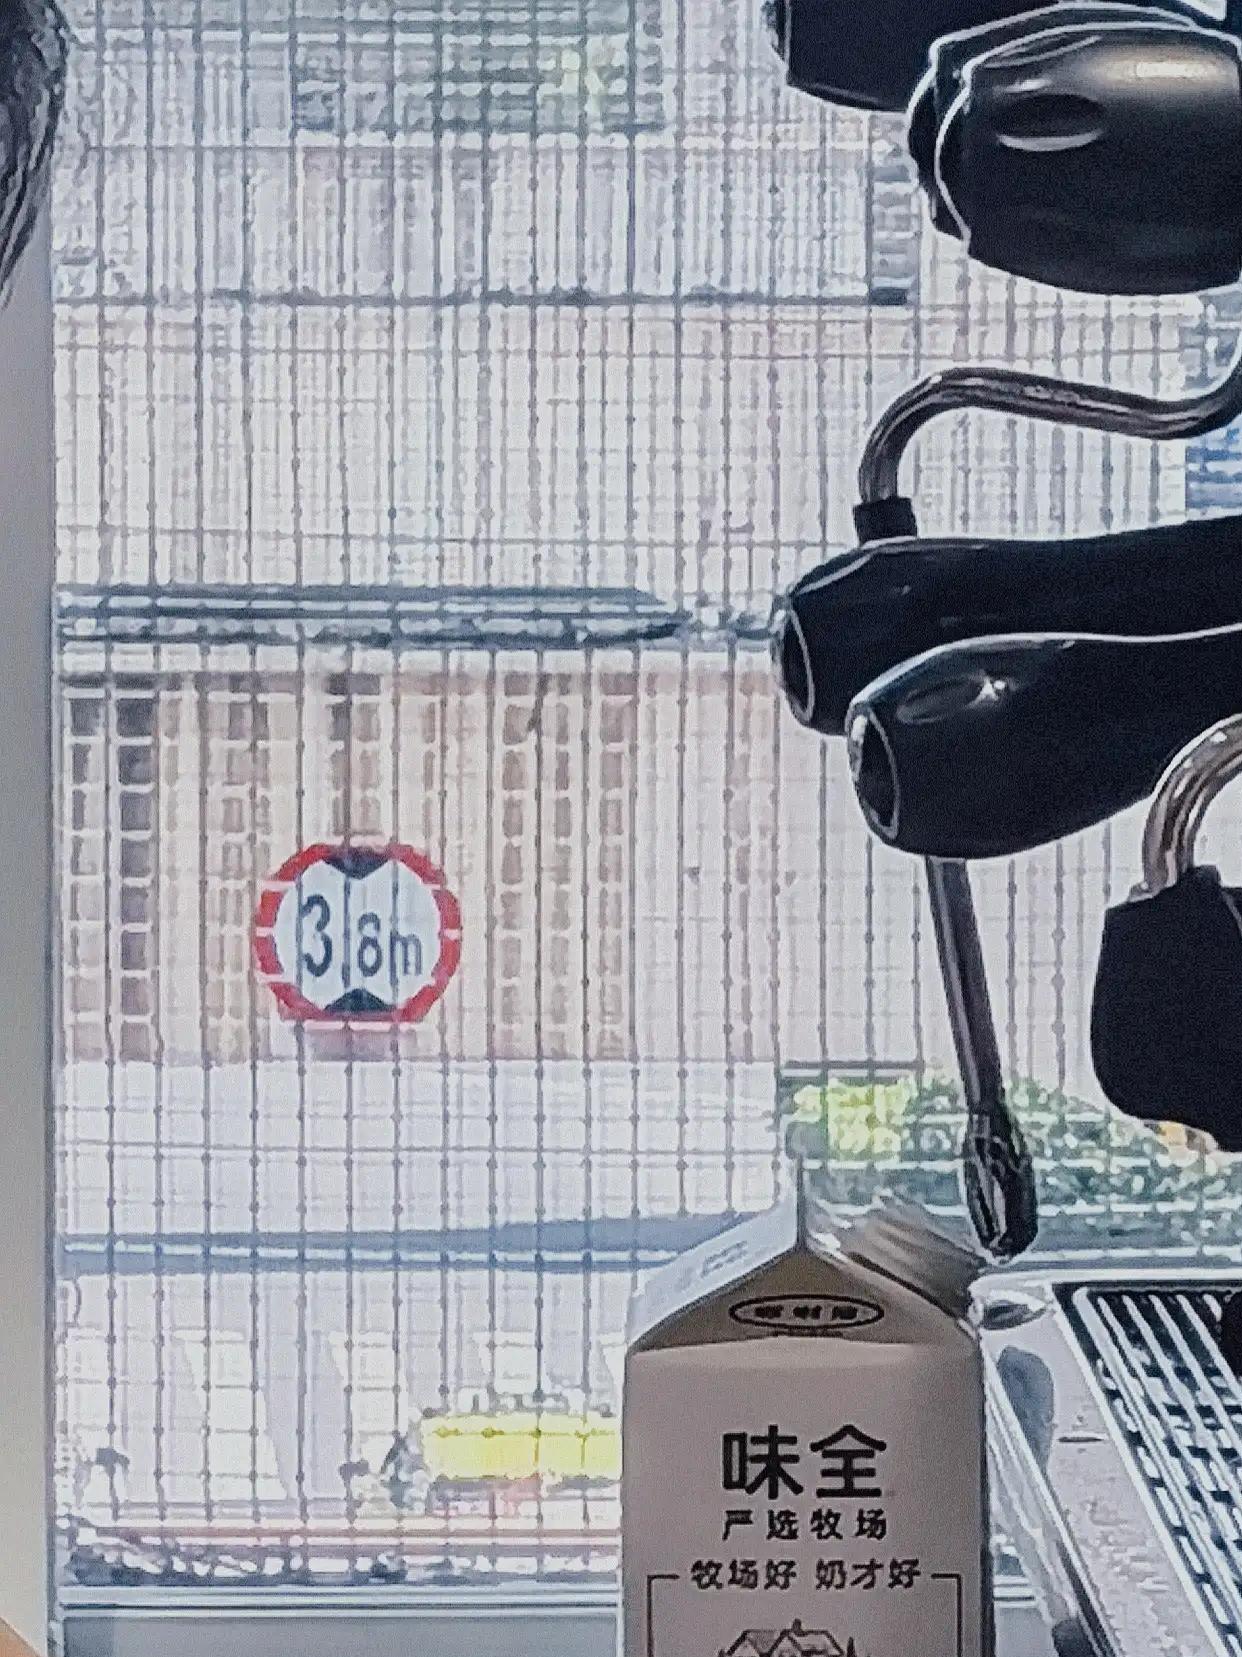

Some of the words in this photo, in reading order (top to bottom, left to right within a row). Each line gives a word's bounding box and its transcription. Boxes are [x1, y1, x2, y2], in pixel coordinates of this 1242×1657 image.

[722, 1424, 887, 1500] 味全
[722, 1507, 888, 1541] 严选牧场
[690, 1558, 797, 1590] 牧场好
[815, 1557, 922, 1590] 奶才好
